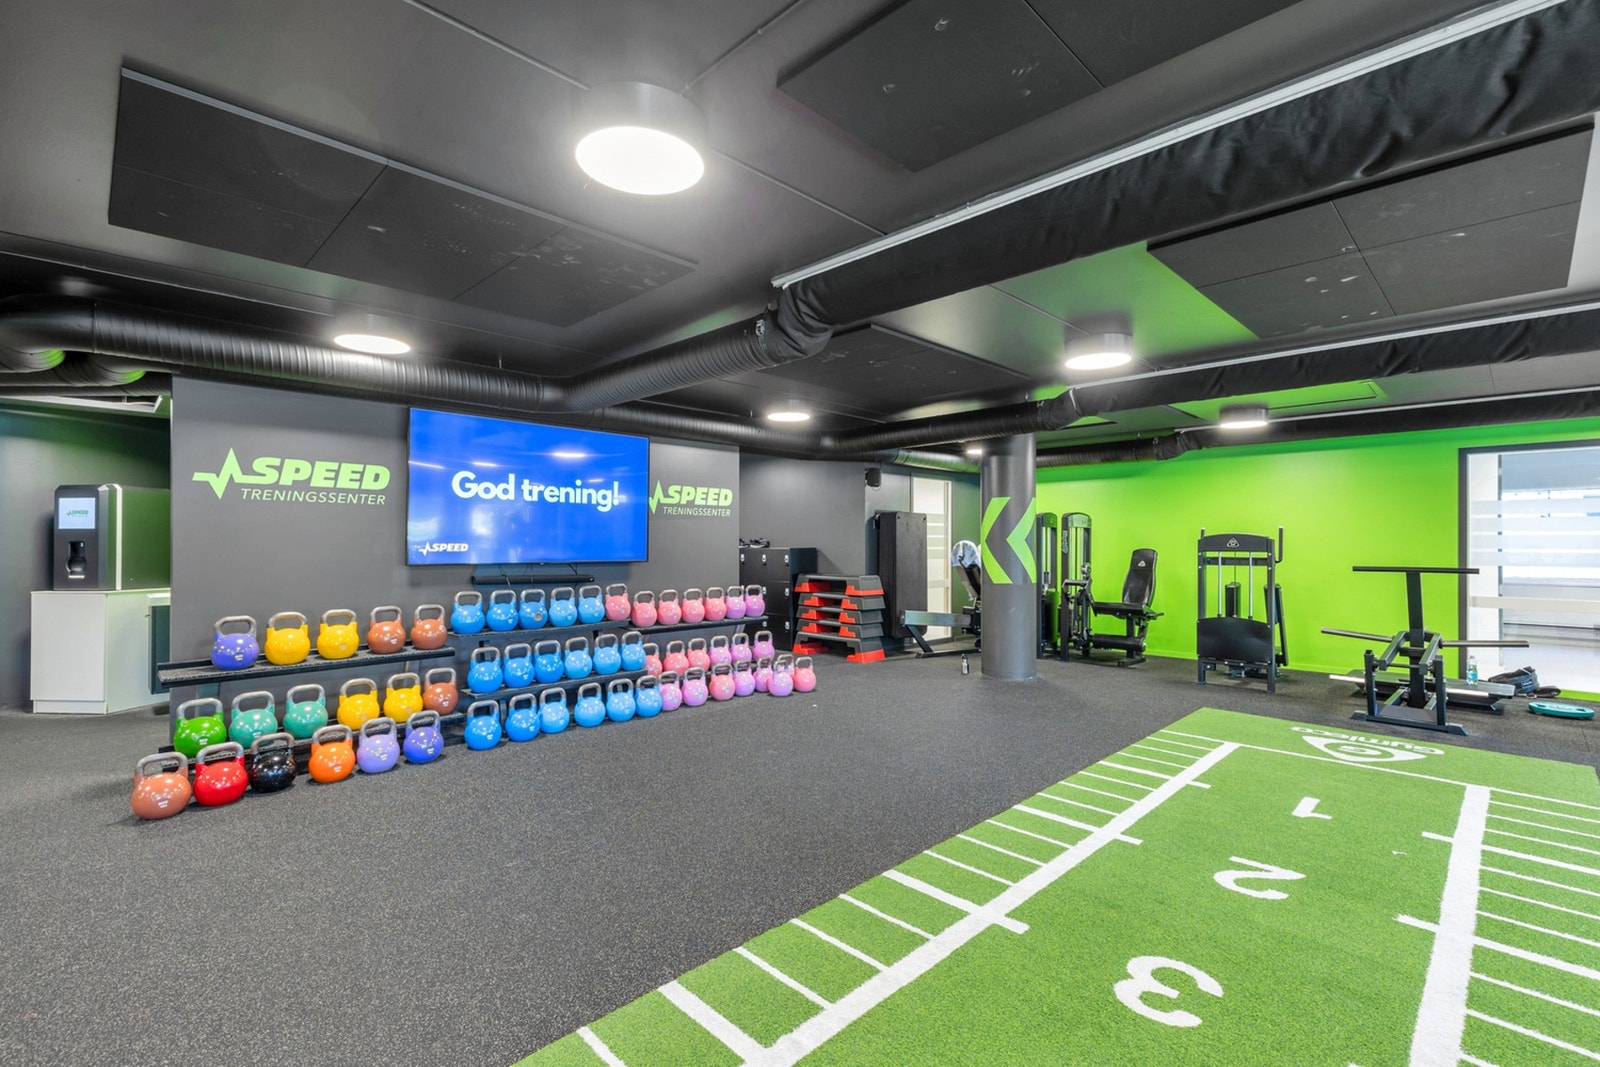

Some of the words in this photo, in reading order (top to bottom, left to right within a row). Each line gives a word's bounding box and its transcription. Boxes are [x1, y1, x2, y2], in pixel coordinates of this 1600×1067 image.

[245, 456, 391, 490] SPEED
[241, 488, 386, 505] TRENINGSSENTER
[451, 470, 515, 501] God
[521, 479, 619, 512] trening!
[666, 485, 733, 507] SPEED
[662, 506, 731, 517] TRENINGSSENTER
[430, 543, 469, 553] SPEED
[1291, 796, 1332, 819] 1
[1213, 856, 1306, 900] 2
[1113, 956, 1224, 1028] 3
